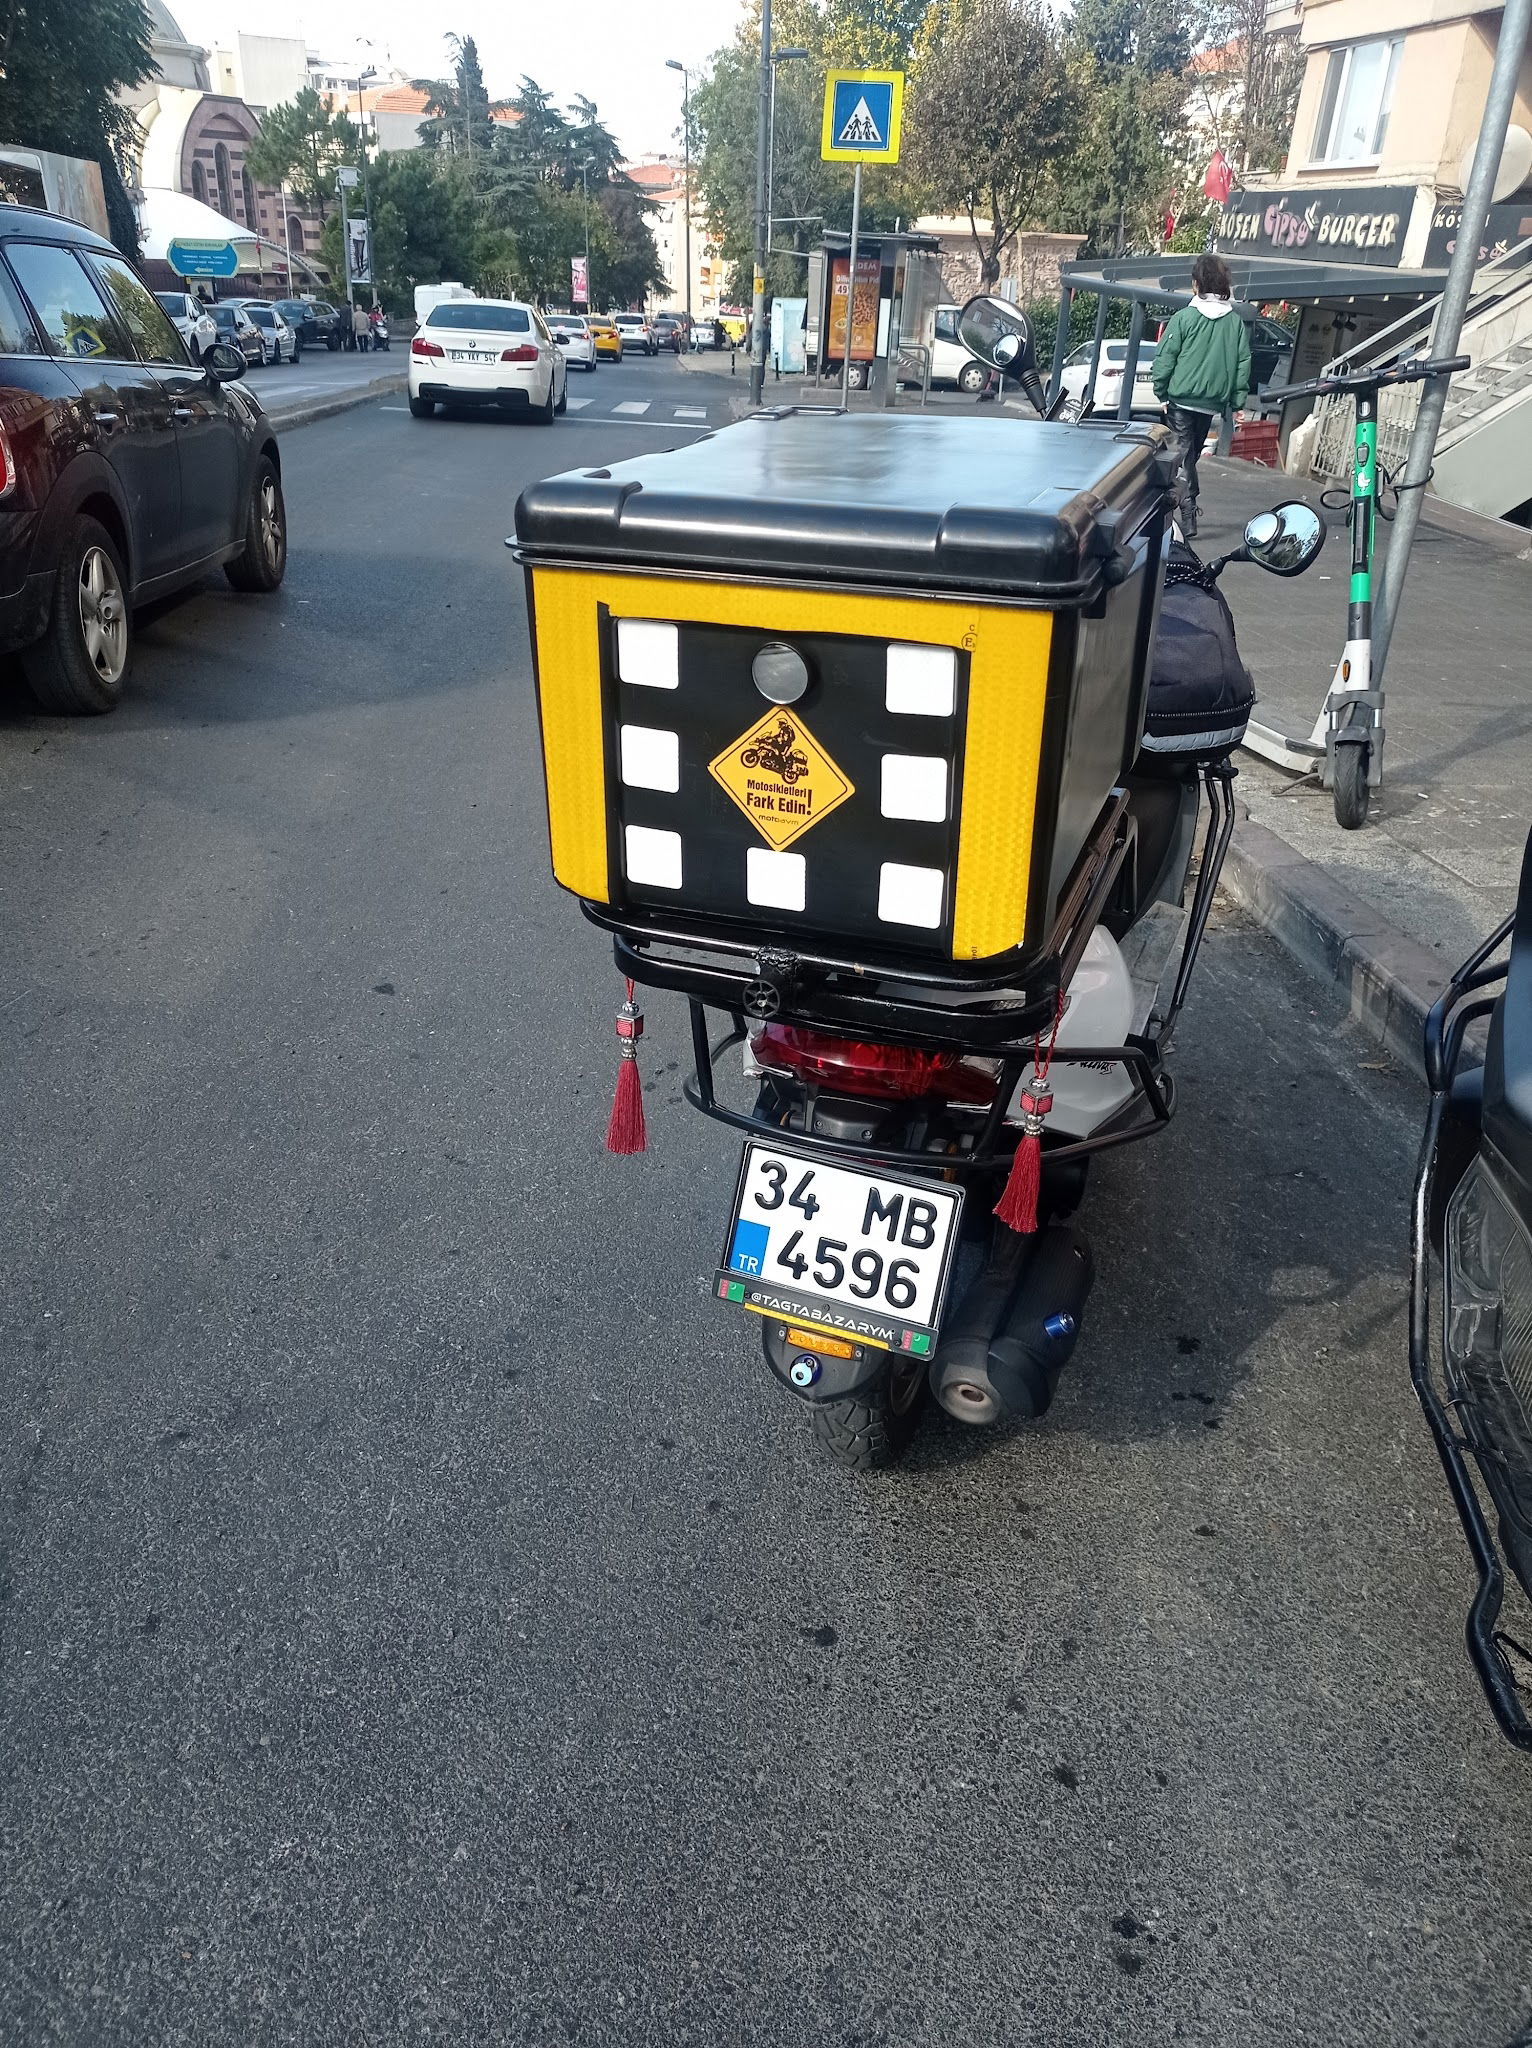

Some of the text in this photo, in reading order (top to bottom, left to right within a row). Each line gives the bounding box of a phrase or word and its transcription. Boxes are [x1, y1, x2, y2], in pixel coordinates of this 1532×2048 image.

[1316, 213, 1398, 249] BURGER
[746, 790, 813, 816] Fark Edin!
[747, 779, 807, 798] Motosikletleri
[754, 1160, 938, 1250] 34 MB
[738, 1253, 759, 1273] TR
[777, 1230, 920, 1309] 4596
[751, 1293, 895, 1341] @TAGTABAZARYM
